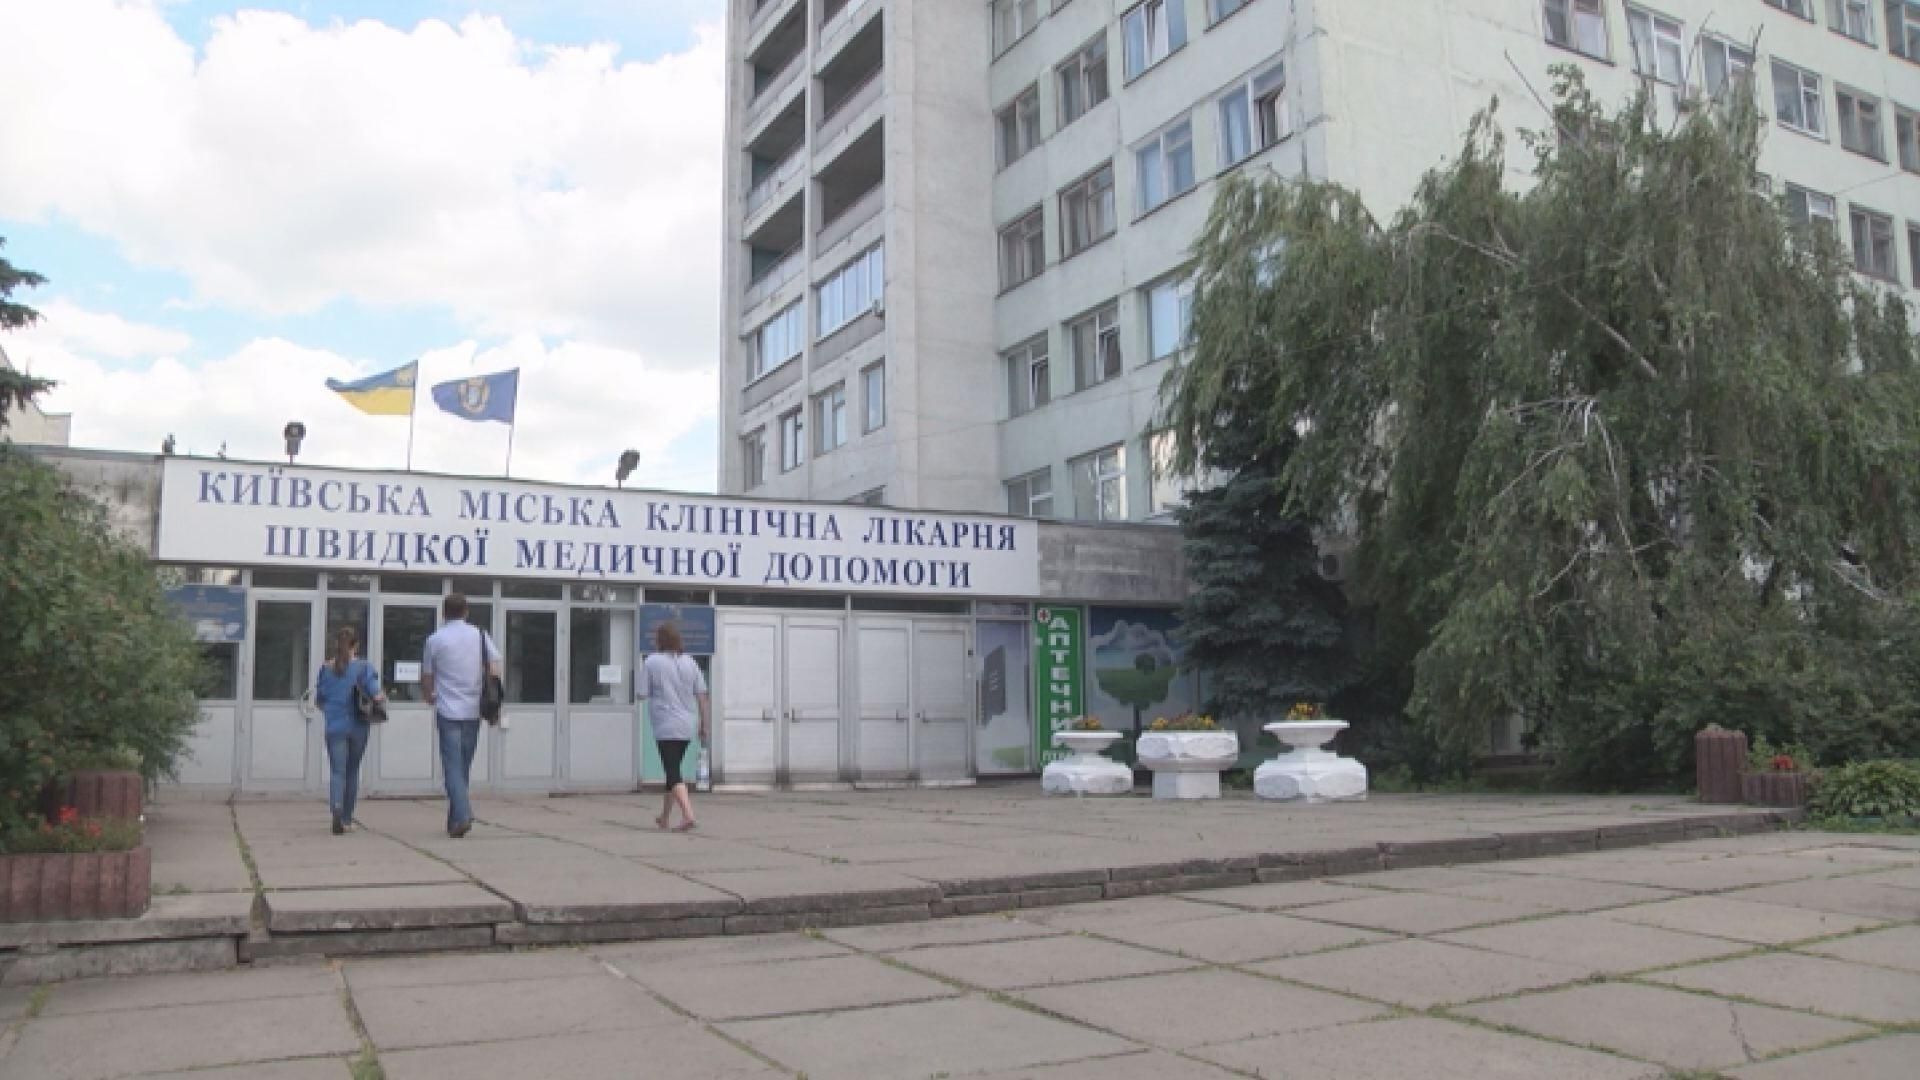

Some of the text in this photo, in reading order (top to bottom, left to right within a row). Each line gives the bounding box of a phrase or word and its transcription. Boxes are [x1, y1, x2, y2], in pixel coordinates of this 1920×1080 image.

[198, 467, 1017, 551] КИЇВСЬКА МІСЬКА КЛІНІЧНА ЛІКАРНЯ
[265, 524, 971, 588] ШВИДКОЇ МЕДИЧНОЇ ДОПОМОГИ
[1048, 617, 1073, 747] АПТЕЧНИ
